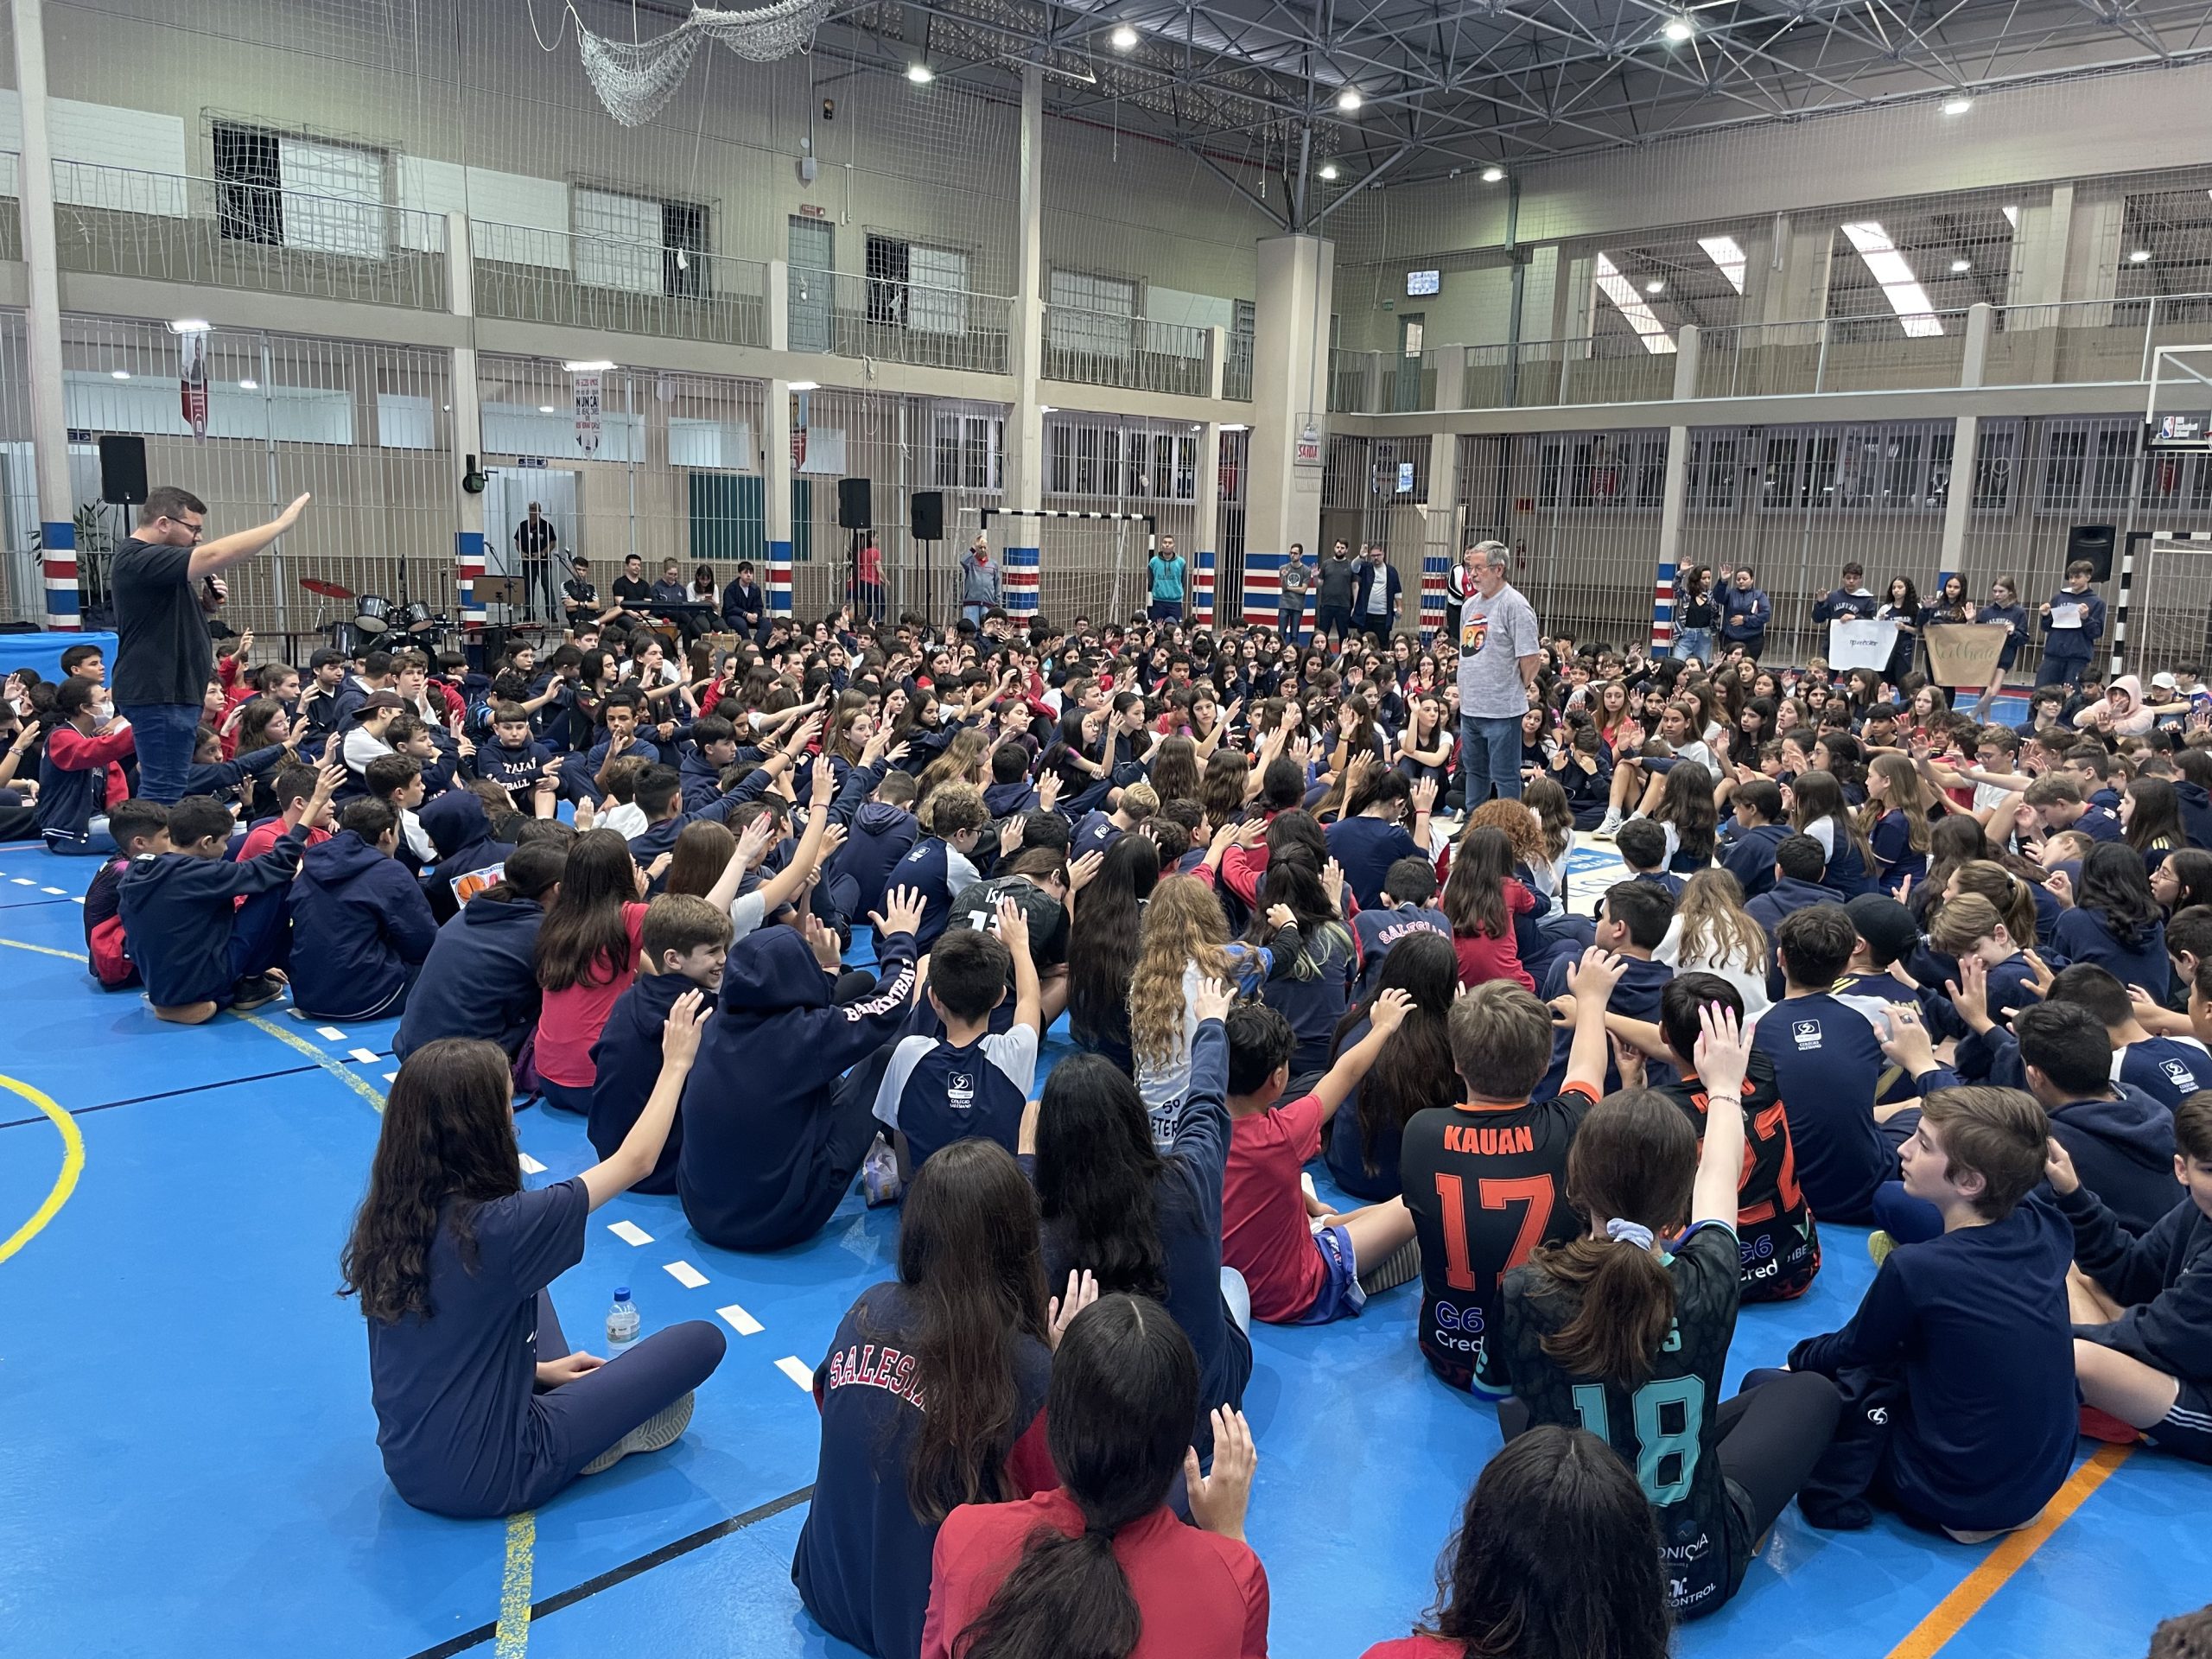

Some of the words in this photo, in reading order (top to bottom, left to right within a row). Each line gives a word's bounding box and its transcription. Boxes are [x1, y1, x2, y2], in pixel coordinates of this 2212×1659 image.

[1444, 1125, 1534, 1155] KAUAN
[1435, 1172, 1555, 1291] 17
[1435, 1300, 1485, 1333] G6
[1435, 1329, 1484, 1352] Cred
[1572, 1373, 1705, 1508] 18
